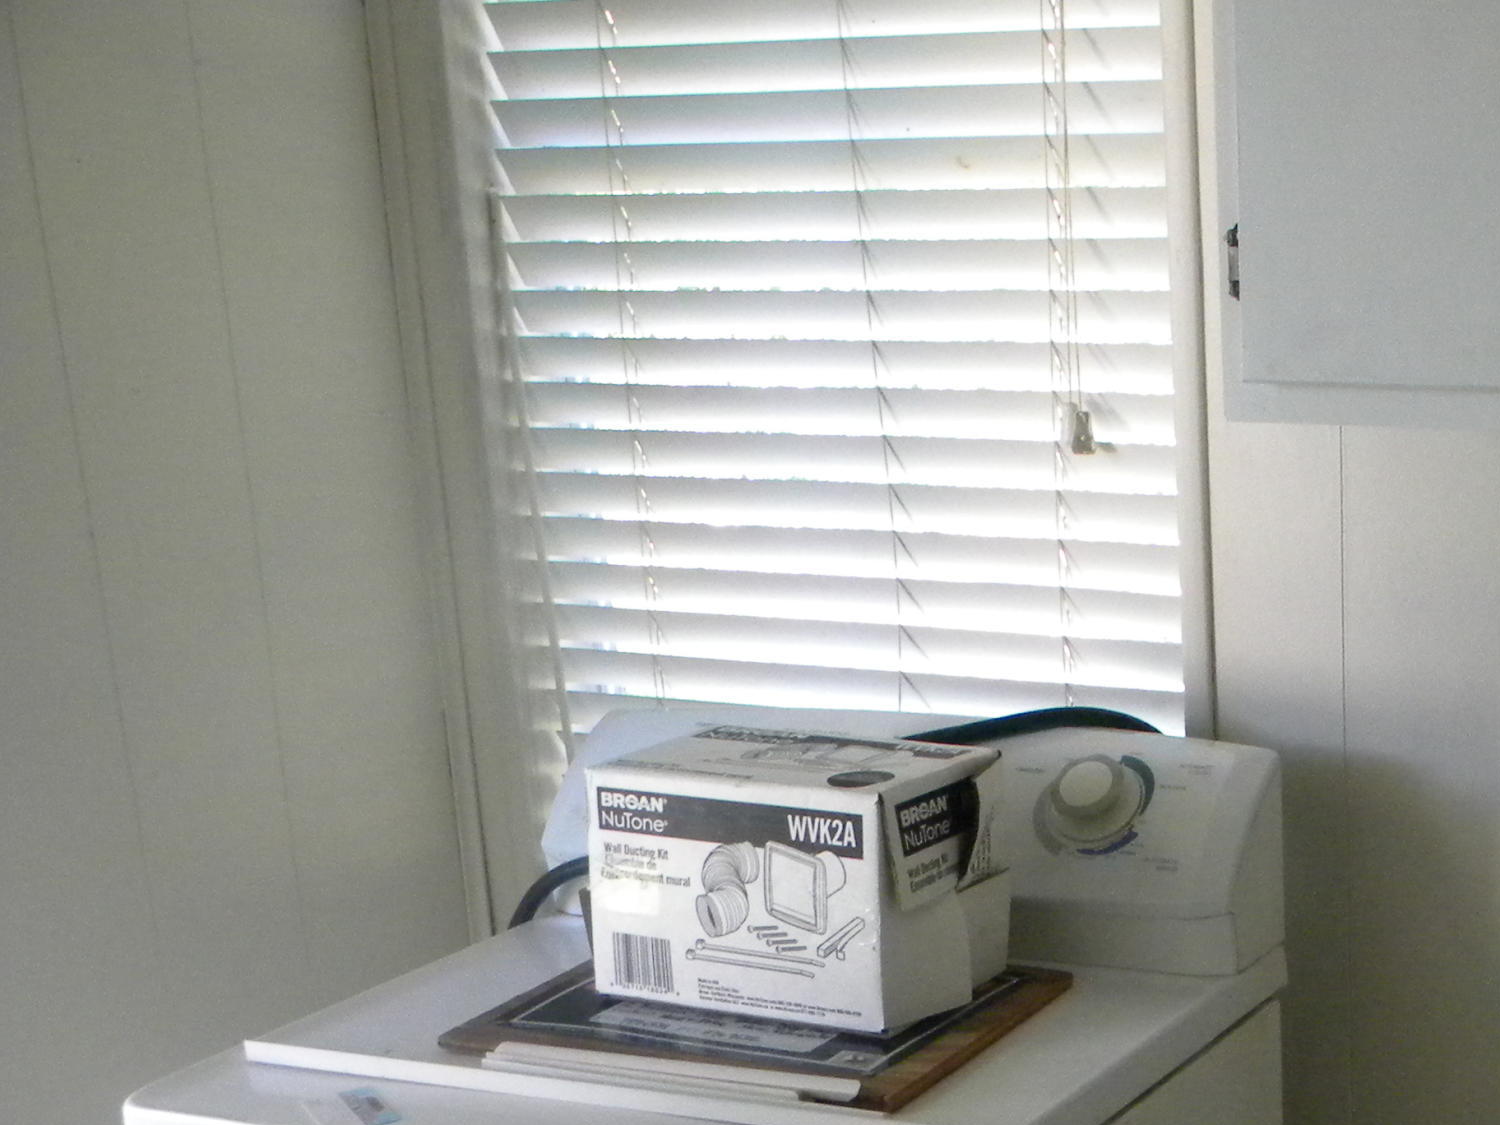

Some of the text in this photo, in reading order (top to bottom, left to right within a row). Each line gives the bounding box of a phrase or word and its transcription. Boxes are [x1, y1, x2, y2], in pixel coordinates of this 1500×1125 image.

[600, 791, 664, 813] BROAN
[900, 795, 948, 827] BROAN
[602, 810, 665, 833] NuTone
[788, 813, 857, 849] WVK2A
[903, 819, 951, 851] NuTone
